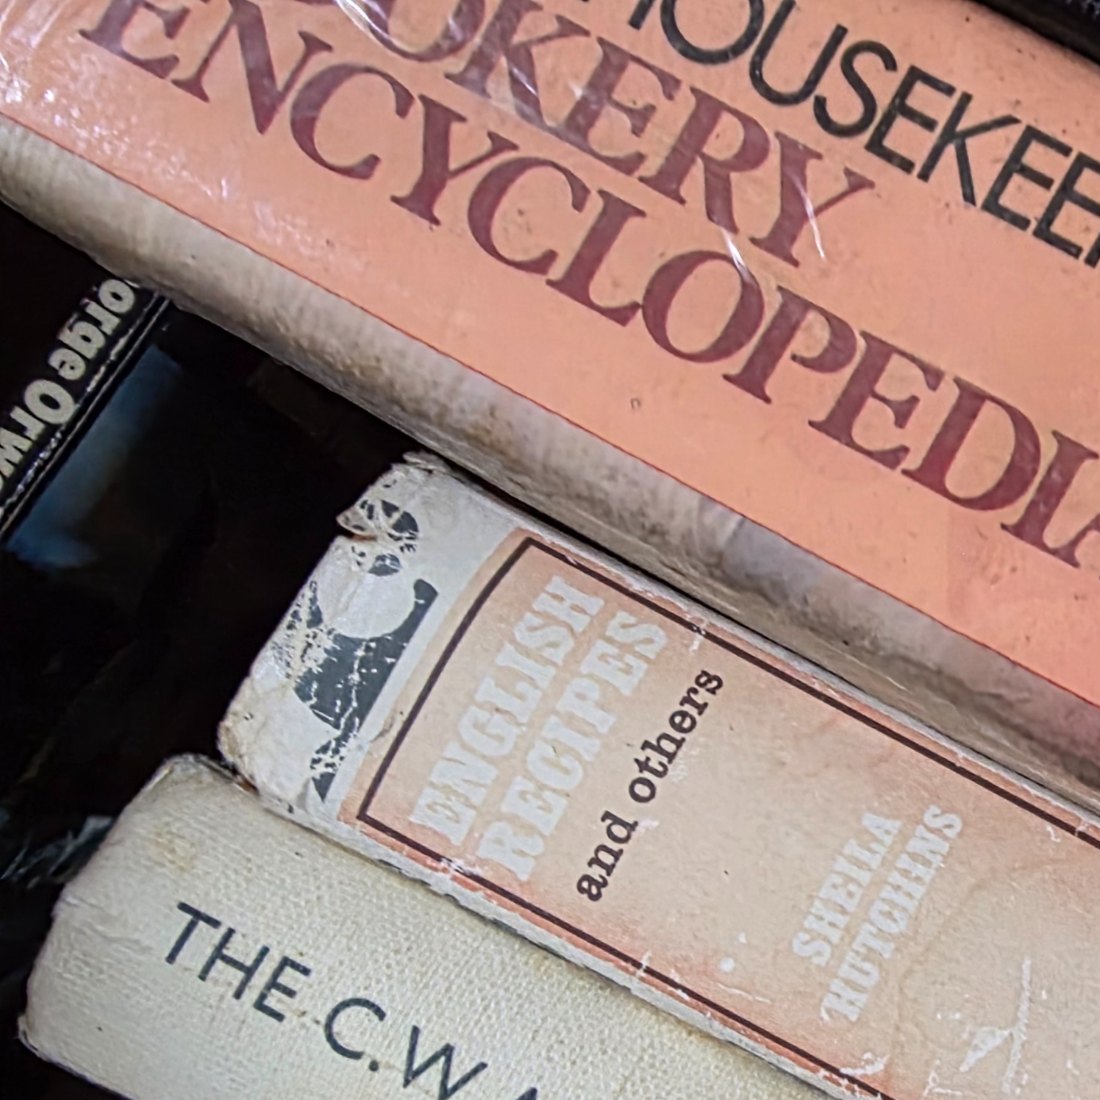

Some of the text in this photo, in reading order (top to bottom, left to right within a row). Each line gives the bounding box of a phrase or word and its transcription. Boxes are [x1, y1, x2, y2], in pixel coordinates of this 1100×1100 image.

[408, 576, 605, 845] ENGLISH
[475, 611, 669, 883] RECIPES
[576, 668, 724, 902] and others
[165, 902, 312, 1022] THE
[791, 808, 901, 968] SHEILA
[820, 804, 964, 1023] HUTCHINS
